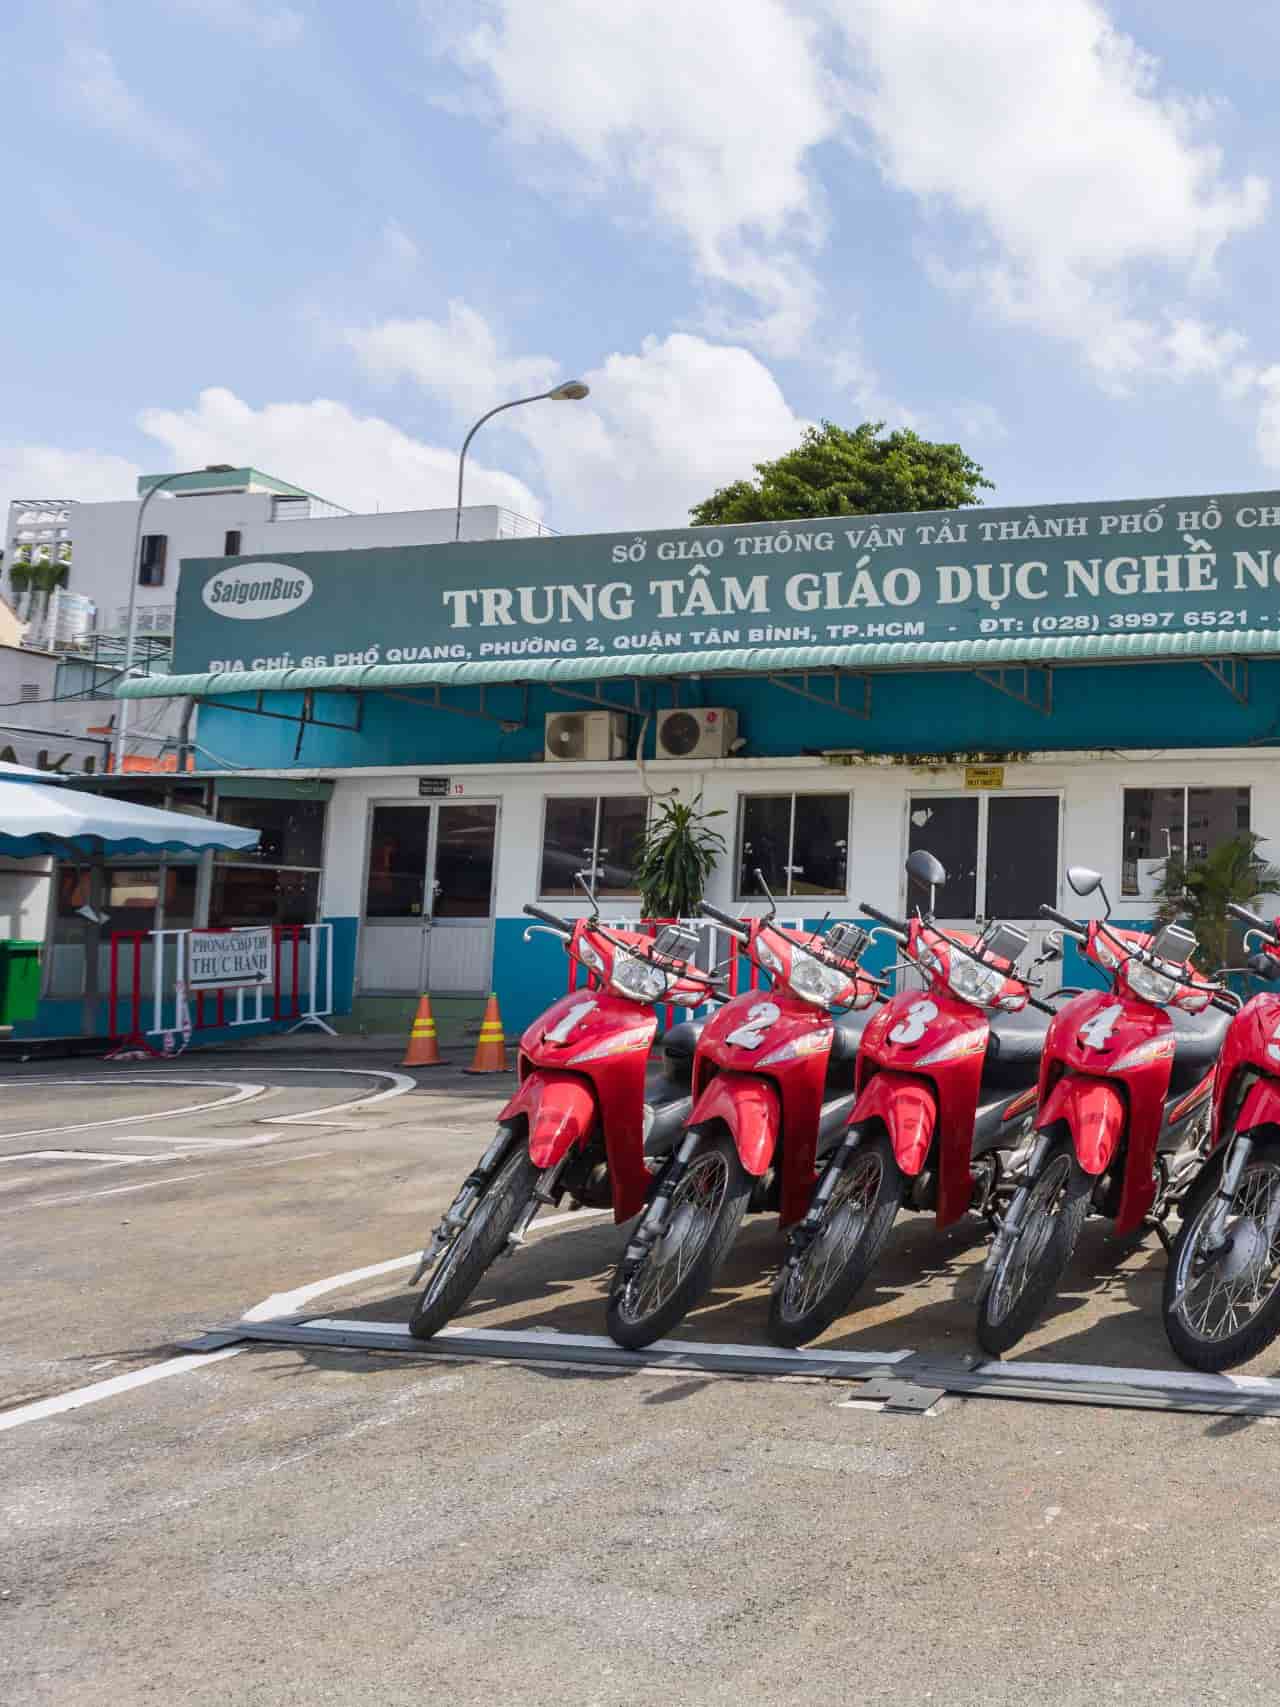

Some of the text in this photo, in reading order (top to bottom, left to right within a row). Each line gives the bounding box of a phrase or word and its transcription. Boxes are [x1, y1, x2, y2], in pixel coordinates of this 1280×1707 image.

[612, 537, 647, 563] SỞ
[657, 539, 724, 562] GIAO
[734, 529, 835, 555] THÔNG
[845, 524, 906, 552] VẬN
[916, 517, 968, 545] TẢI
[978, 510, 1089, 541] THÀNH
[1099, 503, 1166, 535] PHỐ
[1177, 498, 1224, 531] HỒ
[210, 574, 305, 604] SaigonBus
[442, 582, 635, 629] TRUNG
[649, 564, 771, 620] TÂM
[784, 555, 921, 612] GIÁO
[935, 561, 1049, 611] DỤC
[1064, 534, 1218, 599] NGHỀ
[301, 656, 327, 668] 66
[334, 643, 381, 666] PHỐ
[386, 643, 472, 660] QUANG,
[479, 635, 577, 655] PHƯỜNG
[613, 624, 682, 651] QUẬN
[689, 623, 739, 645] TÂN
[748, 622, 817, 644] BÌNH,
[825, 621, 925, 639] TP.HCM
[979, 617, 1023, 633] ĐT:
[1032, 613, 1100, 633] (028)
[1108, 611, 1174, 628] 3997
[1183, 609, 1249, 626] 6521
[544, 1000, 599, 1043] 1
[726, 1002, 780, 1049] 2
[889, 999, 938, 1044] 3
[1078, 1003, 1124, 1049] 4
